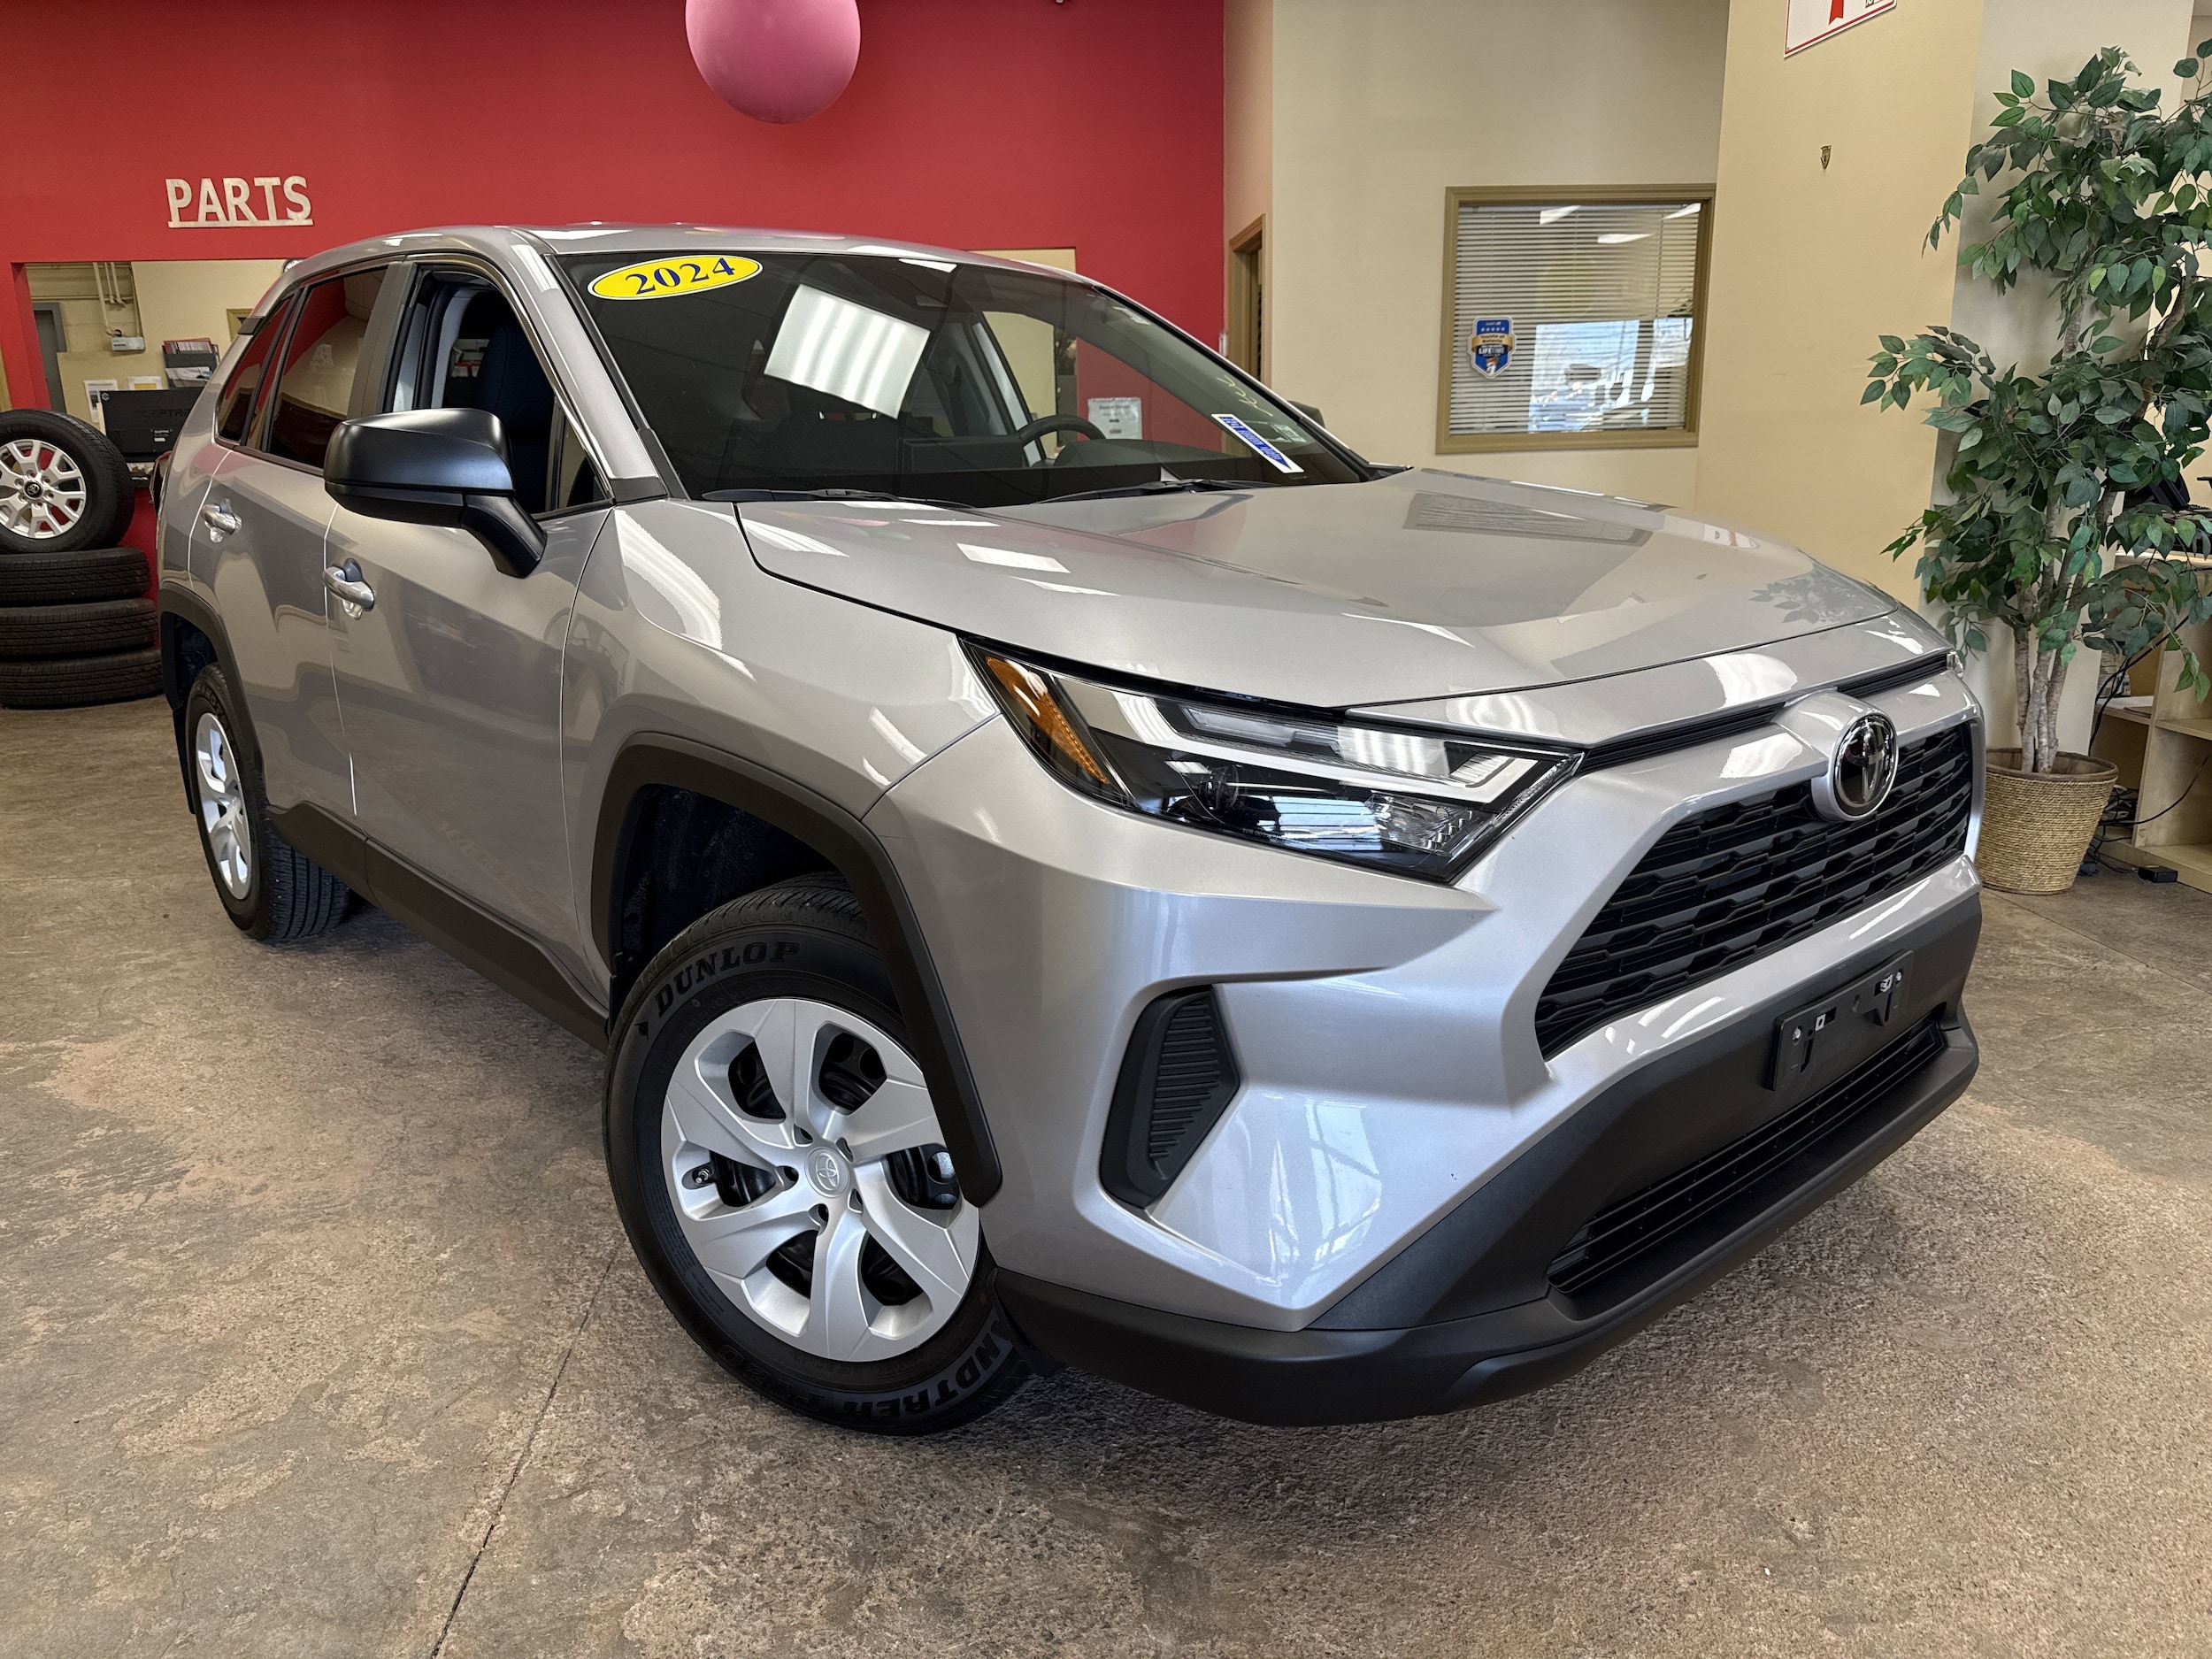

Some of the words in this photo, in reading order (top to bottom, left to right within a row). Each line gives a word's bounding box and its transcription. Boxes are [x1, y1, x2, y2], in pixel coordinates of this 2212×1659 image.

[165, 175, 312, 225] PARTS
[626, 257, 735, 295] 2024
[655, 941, 800, 1018] DUNLOP
